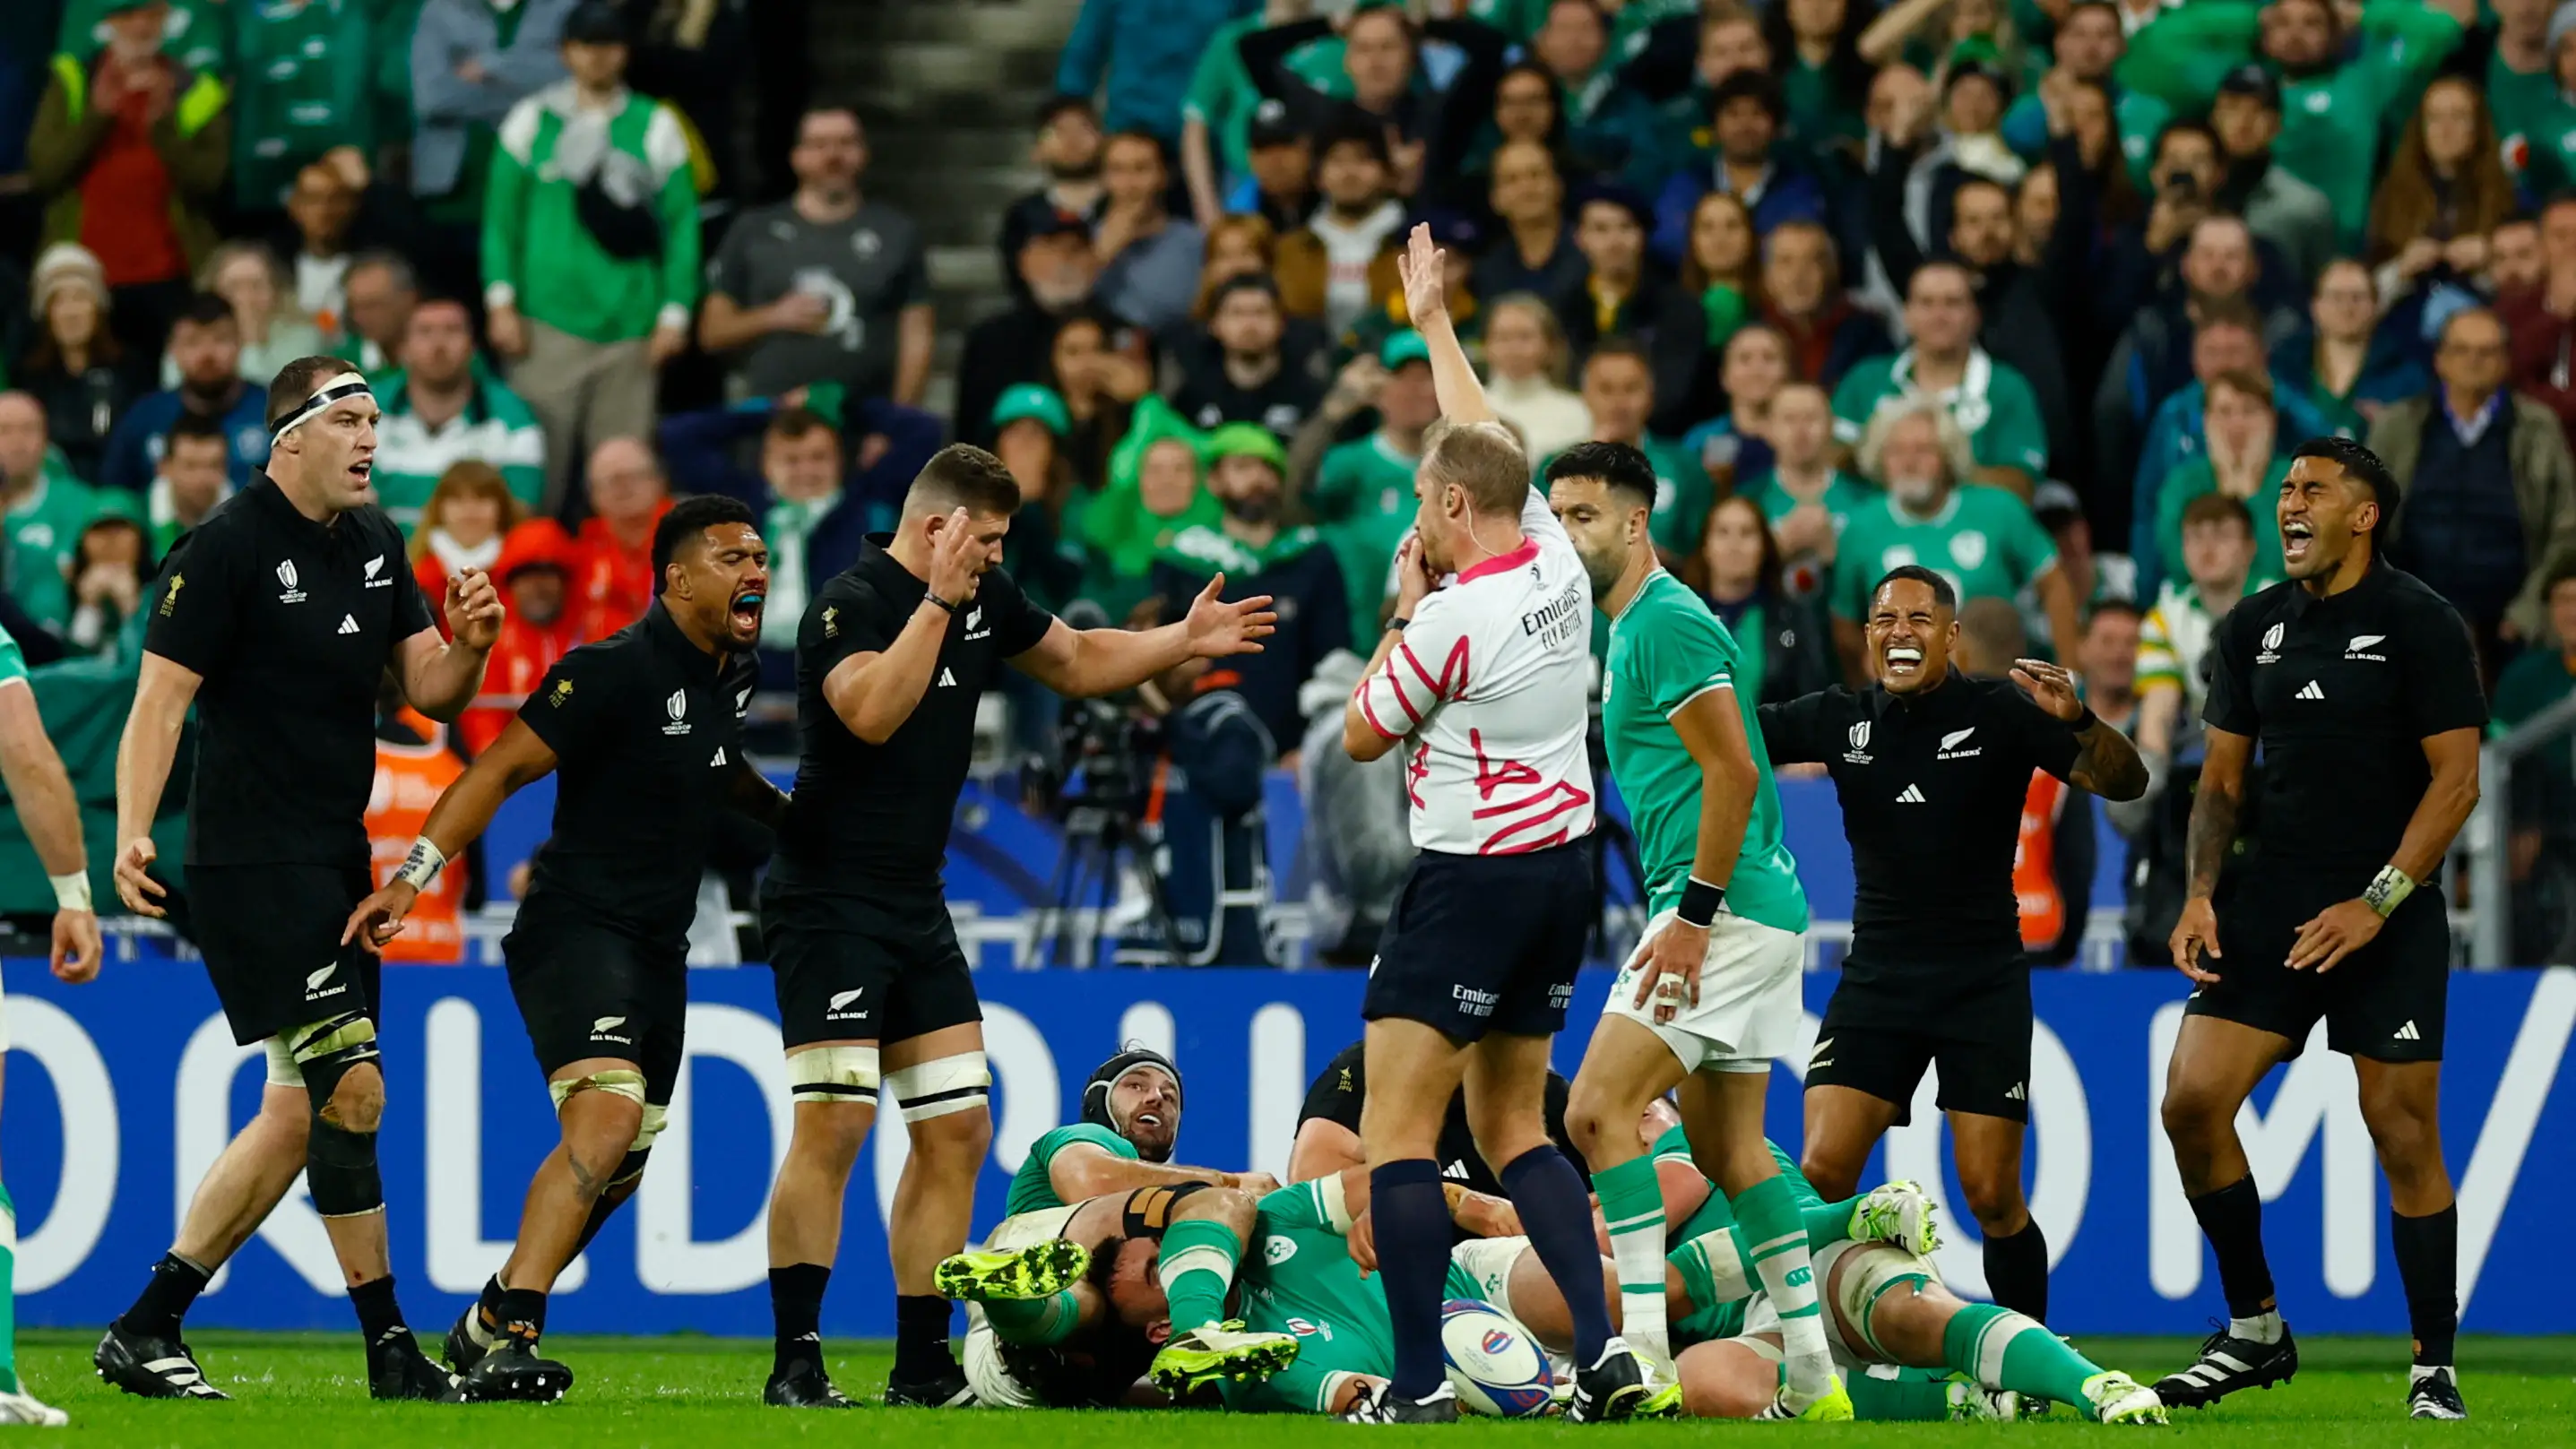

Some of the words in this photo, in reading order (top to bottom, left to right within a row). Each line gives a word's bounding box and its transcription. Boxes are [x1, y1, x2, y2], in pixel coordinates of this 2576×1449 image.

[1521, 583, 1581, 637] Emirates
[1541, 626, 1559, 650] FLY
[1559, 609, 1582, 640] BETTER
[2356, 653, 2386, 662] BLACKS
[1950, 749, 1981, 759] BLACKS
[306, 992, 319, 1001] ALL
[318, 985, 347, 997] BLACKS
[1548, 982, 1574, 996] Emir
[1458, 1001, 1474, 1013] FLY
[839, 1011, 868, 1019] BLACKS
[604, 1034, 631, 1045] BLACKS
